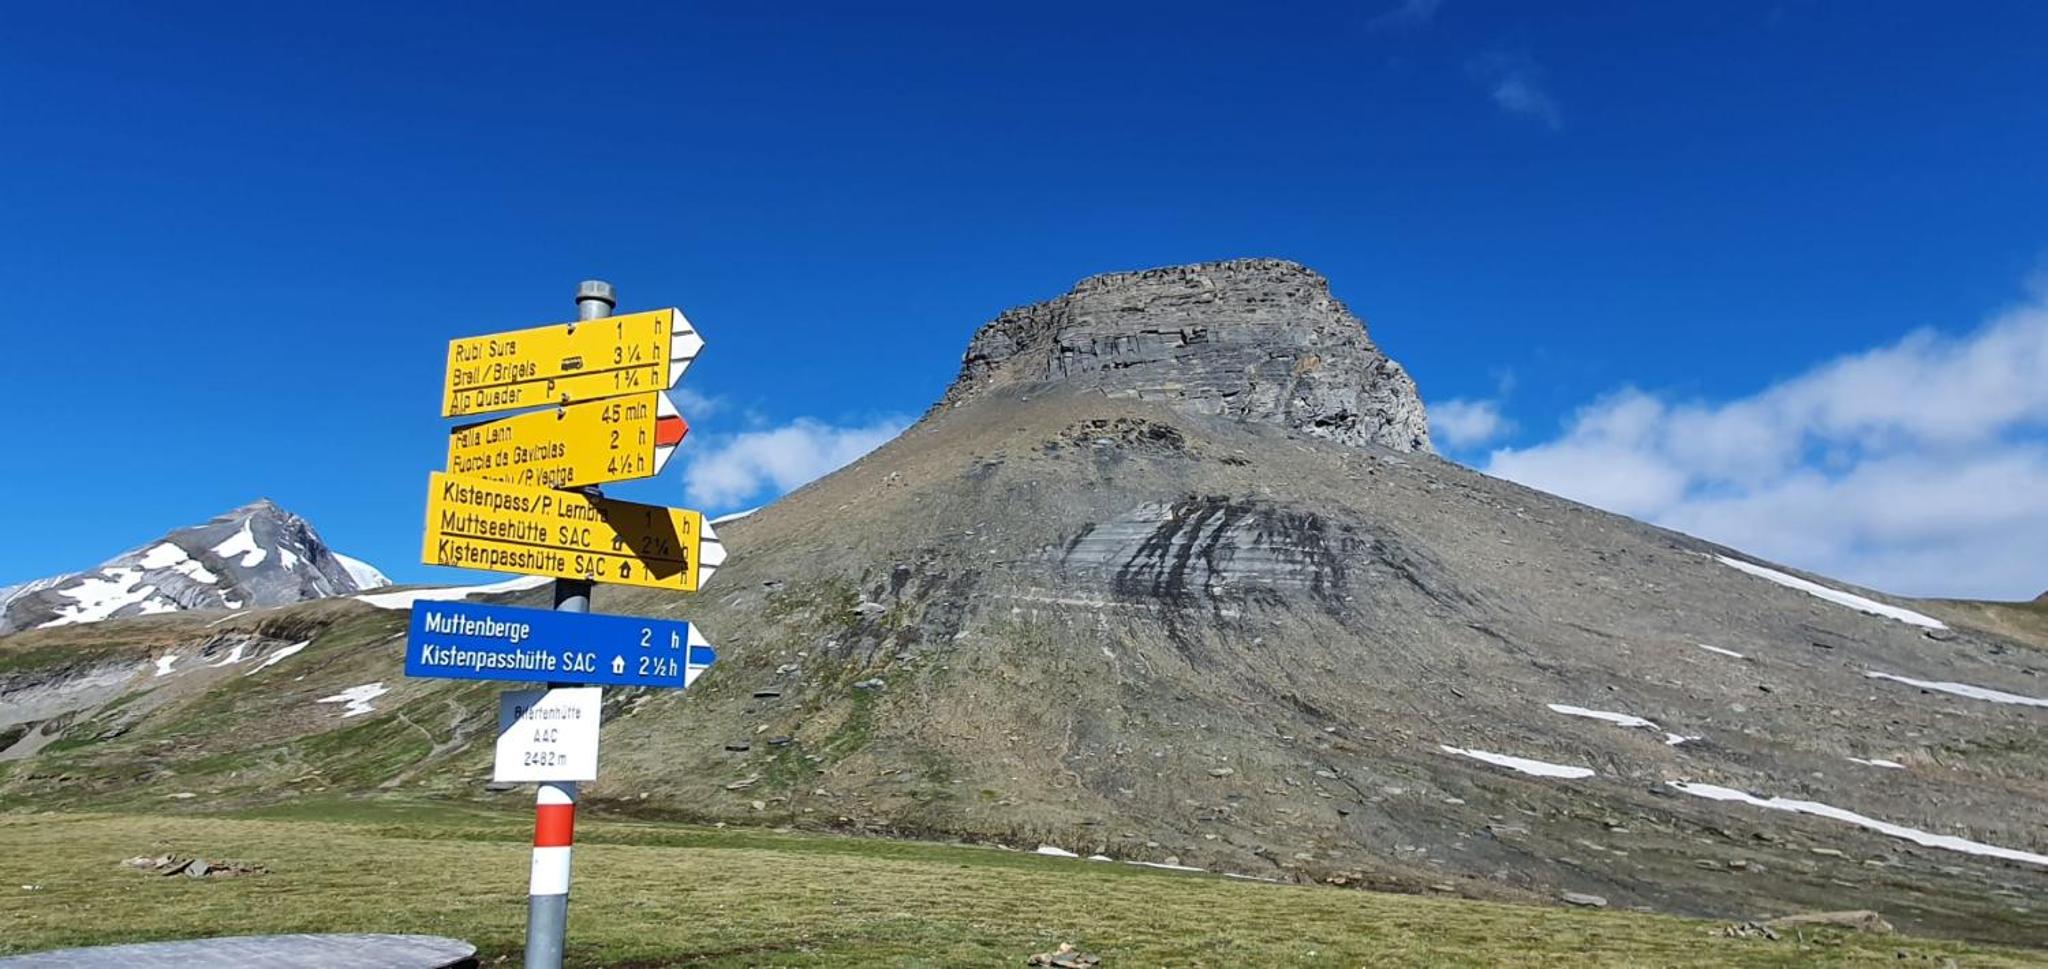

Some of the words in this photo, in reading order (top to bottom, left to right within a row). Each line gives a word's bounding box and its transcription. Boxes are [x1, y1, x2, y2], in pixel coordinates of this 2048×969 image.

[489, 340, 516, 358] Sura
[616, 321, 622, 340] 1
[654, 317, 662, 335] h
[653, 342, 661, 360] h
[450, 392, 471, 412] Alp
[476, 385, 522, 408] Quader
[651, 366, 659, 385] h
[602, 404, 622, 424] 45
[624, 401, 648, 421] min
[610, 430, 621, 449] 2
[638, 427, 646, 446] h
[636, 452, 645, 472] h
[440, 508, 548, 544] Muttseehütte
[558, 525, 591, 548] SAC
[682, 515, 691, 535] h
[438, 538, 566, 574] Kistenpasshütte
[574, 555, 606, 577] SAC
[424, 611, 530, 644] Muttenberge
[640, 627, 652, 648] 2
[671, 629, 680, 649] h
[420, 643, 557, 672] Kistenpasshütte
[562, 651, 597, 673] SAC
[668, 657, 678, 677] h
[533, 728, 558, 743] AAC
[524, 751, 556, 767] 2482
